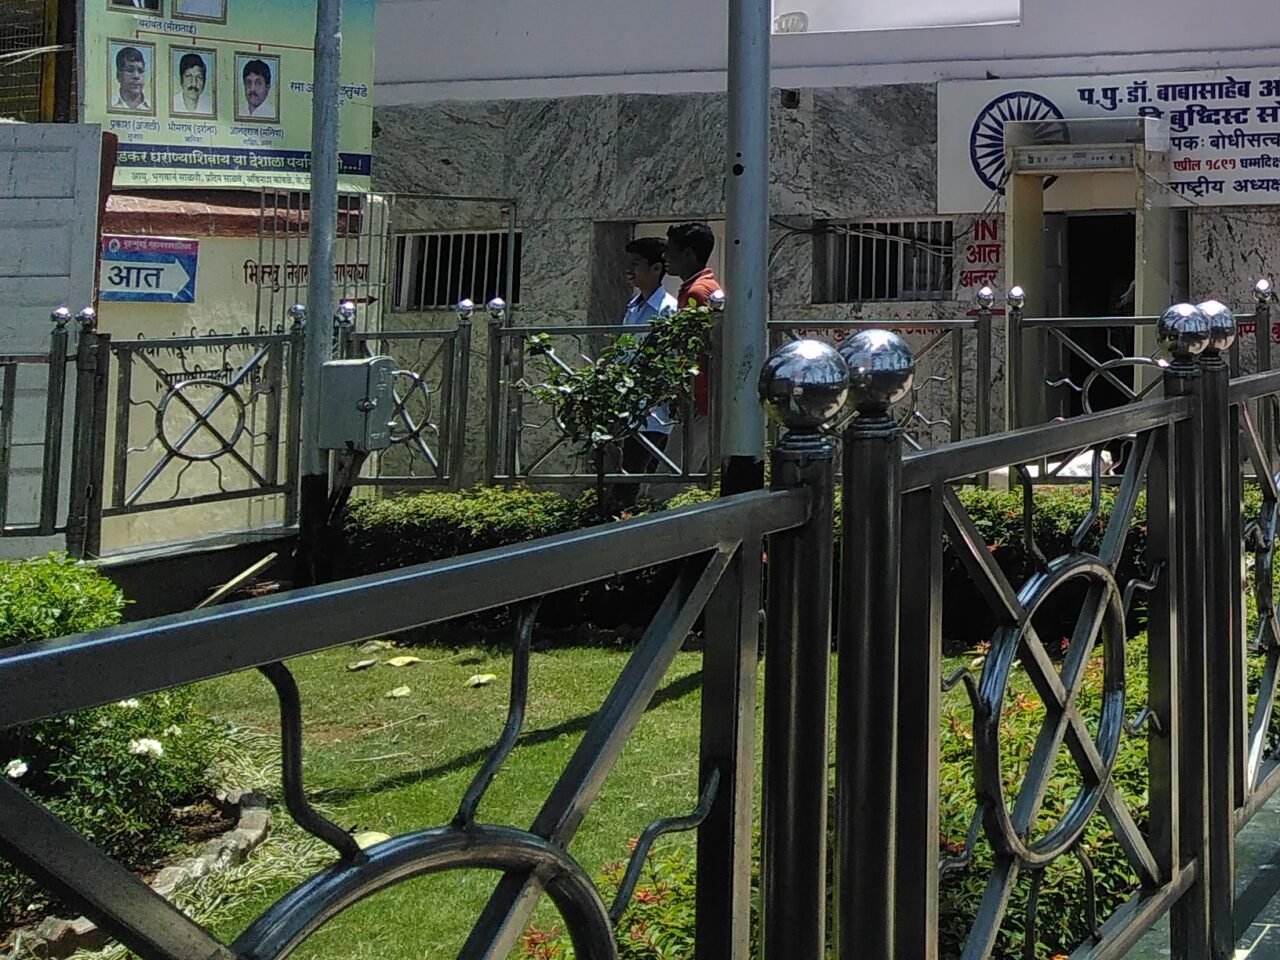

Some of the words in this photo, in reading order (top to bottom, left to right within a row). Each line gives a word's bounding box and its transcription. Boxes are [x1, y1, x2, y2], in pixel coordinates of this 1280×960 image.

[1156, 76, 1251, 102] बाबासाहेब
[117, 150, 148, 163] डकर
[1169, 175, 1225, 197] राष्ट्रीय
[974, 220, 998, 241] IN
[966, 243, 1001, 263] आत
[107, 265, 165, 288] आत
[959, 269, 998, 288] अन्दर
